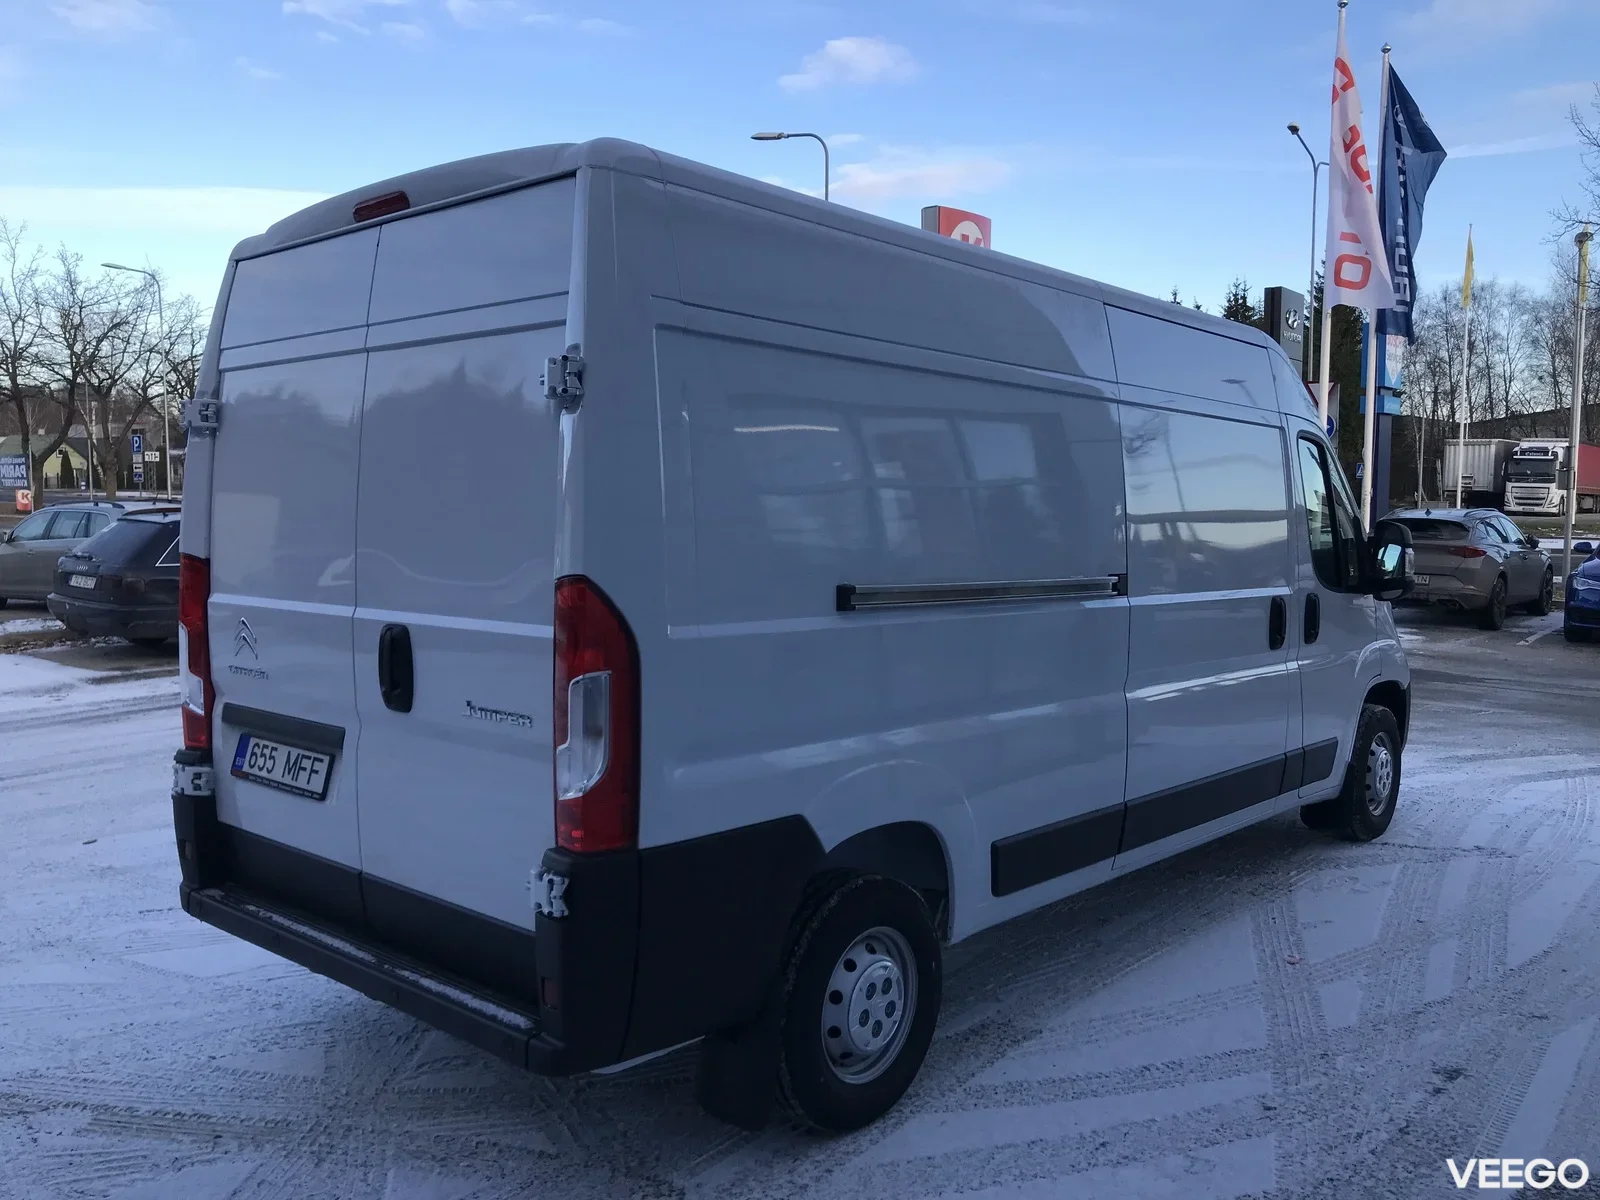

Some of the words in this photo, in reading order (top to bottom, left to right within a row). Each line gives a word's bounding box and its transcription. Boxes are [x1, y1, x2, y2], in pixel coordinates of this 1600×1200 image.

[133, 436, 140, 452] P
[248, 742, 278, 774] 655
[281, 750, 324, 785] MFF
